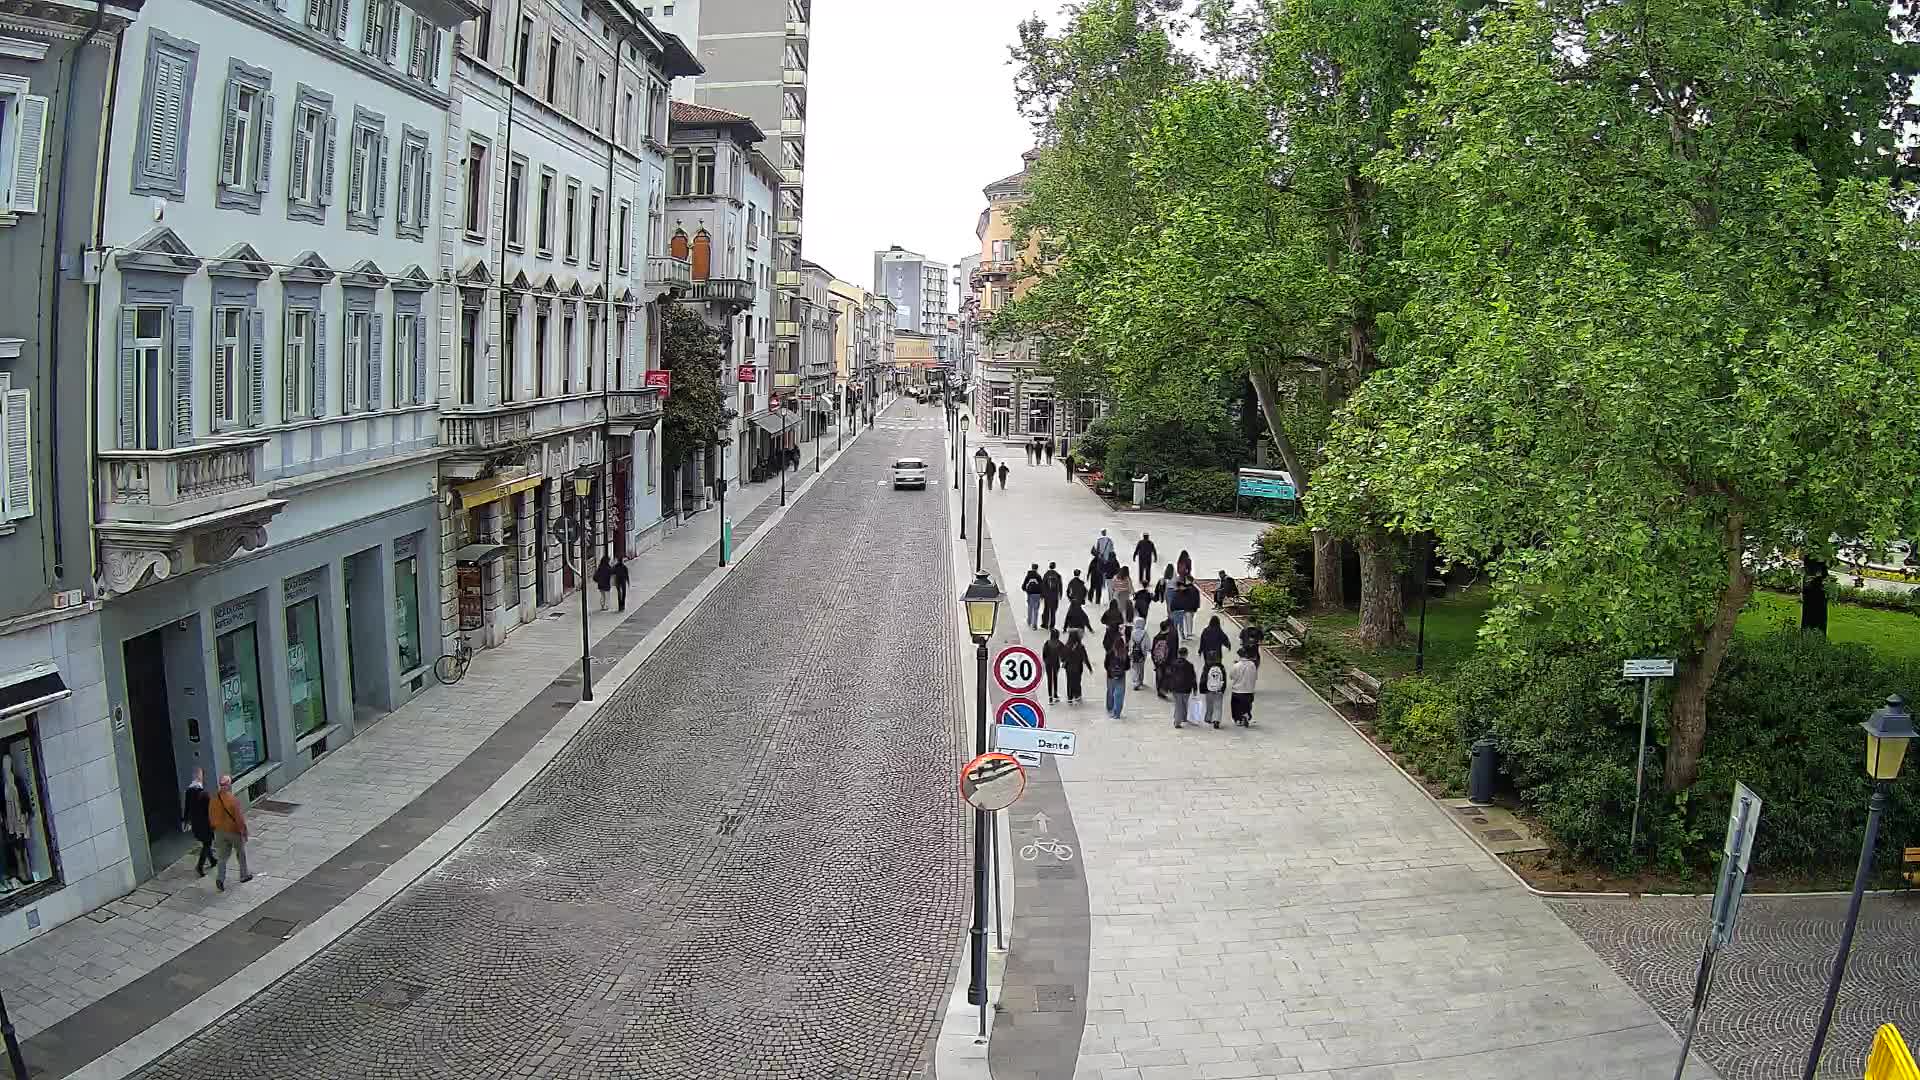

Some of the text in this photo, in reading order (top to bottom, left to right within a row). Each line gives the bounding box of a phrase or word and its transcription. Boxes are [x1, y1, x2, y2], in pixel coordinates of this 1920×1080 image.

[1004, 659, 1033, 681] 30
[221, 678, 240, 701] 130
[1038, 739, 1070, 750] Dante
